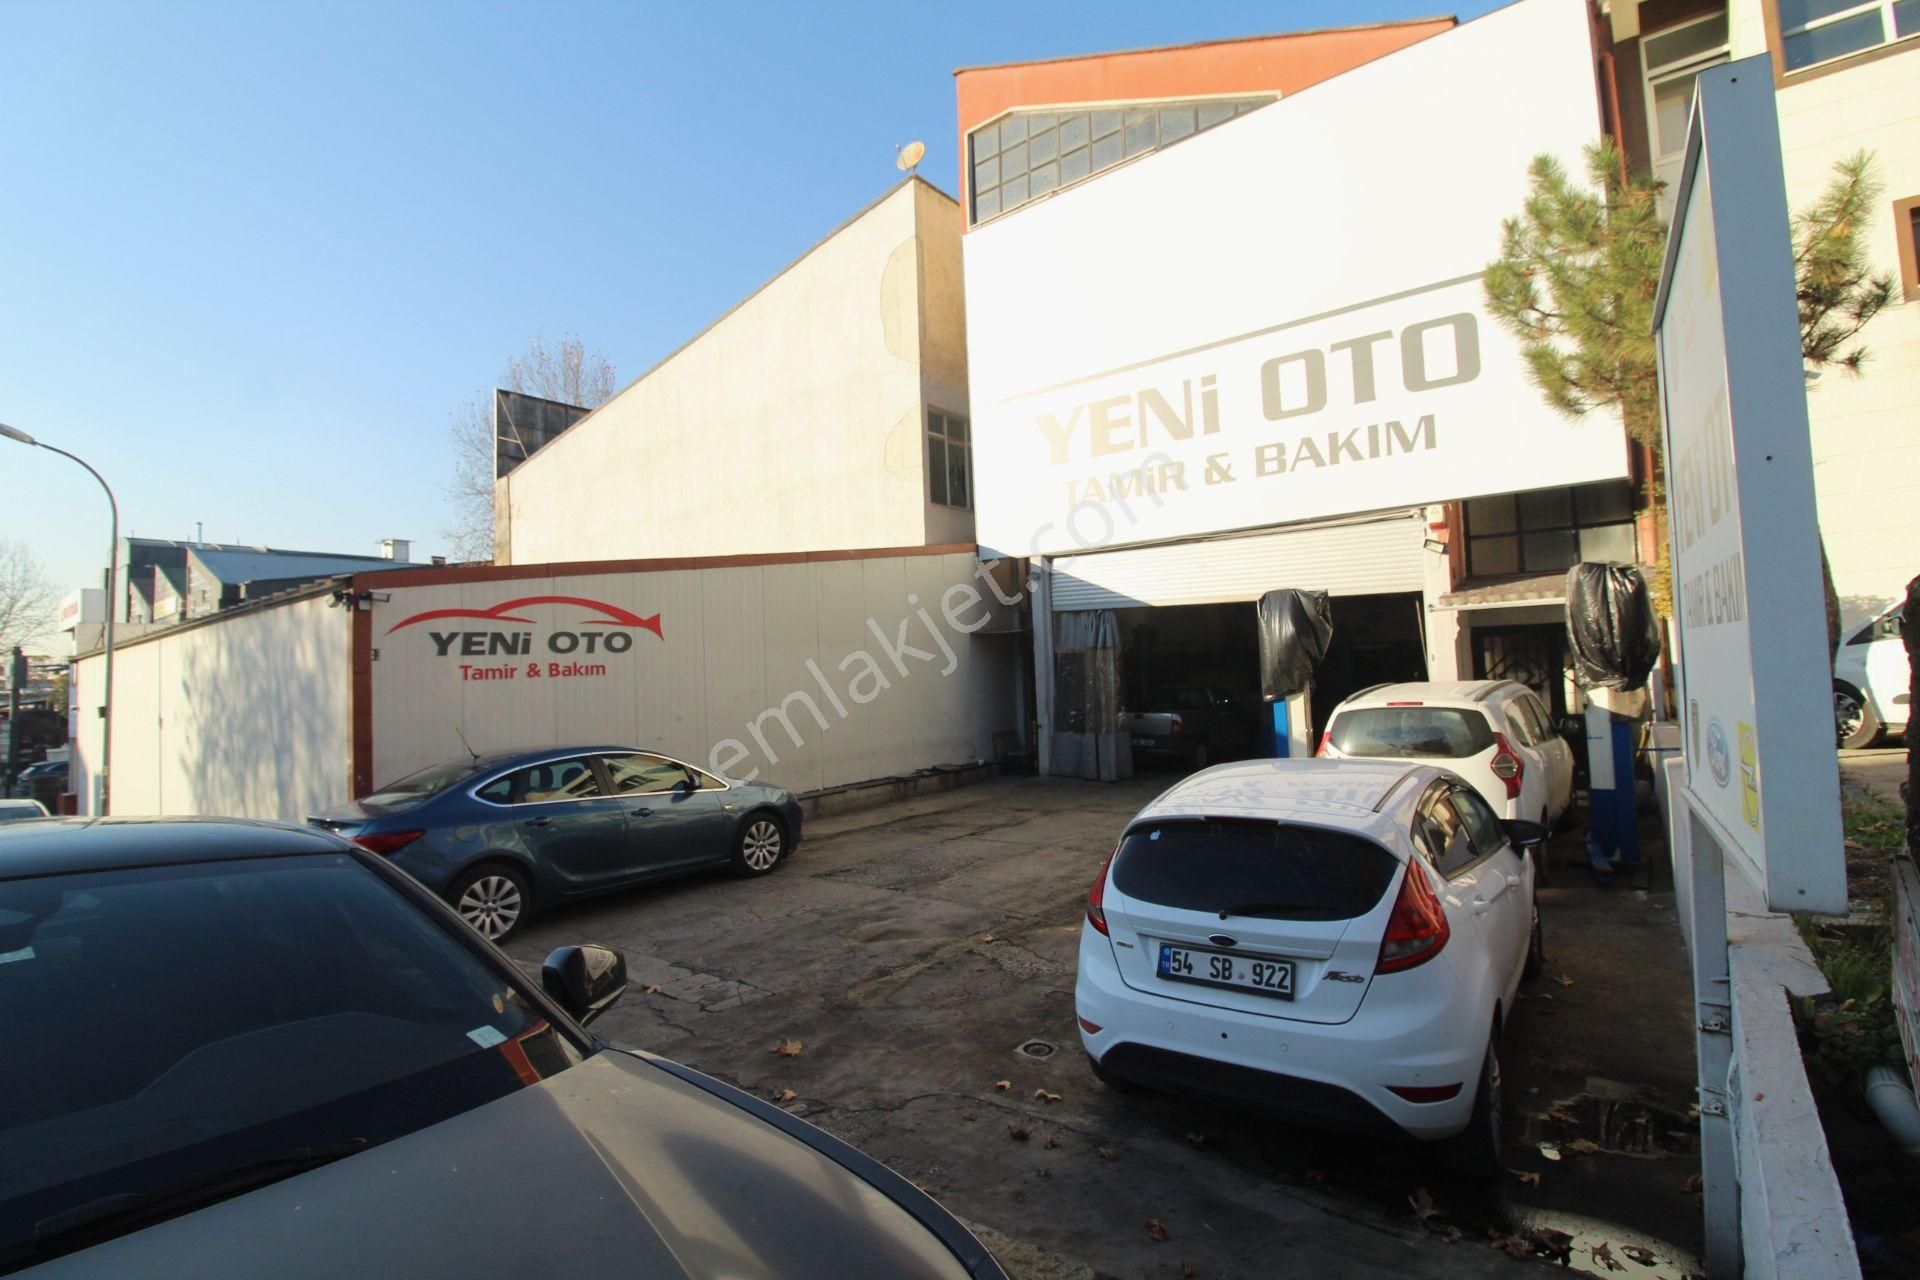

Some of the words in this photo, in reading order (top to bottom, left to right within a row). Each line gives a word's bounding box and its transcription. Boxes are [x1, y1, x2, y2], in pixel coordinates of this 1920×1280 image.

[1261, 312, 1481, 422] OTO
[1204, 452, 1236, 486] &
[1255, 414, 1438, 478] BAKIM
[547, 631, 633, 654] OTO
[459, 664, 517, 681] Tamir
[526, 662, 541, 678] &
[547, 662, 606, 678] Bakım
[1171, 951, 1193, 975] 54
[1209, 956, 1233, 981] SB
[1251, 965, 1290, 991] 922
